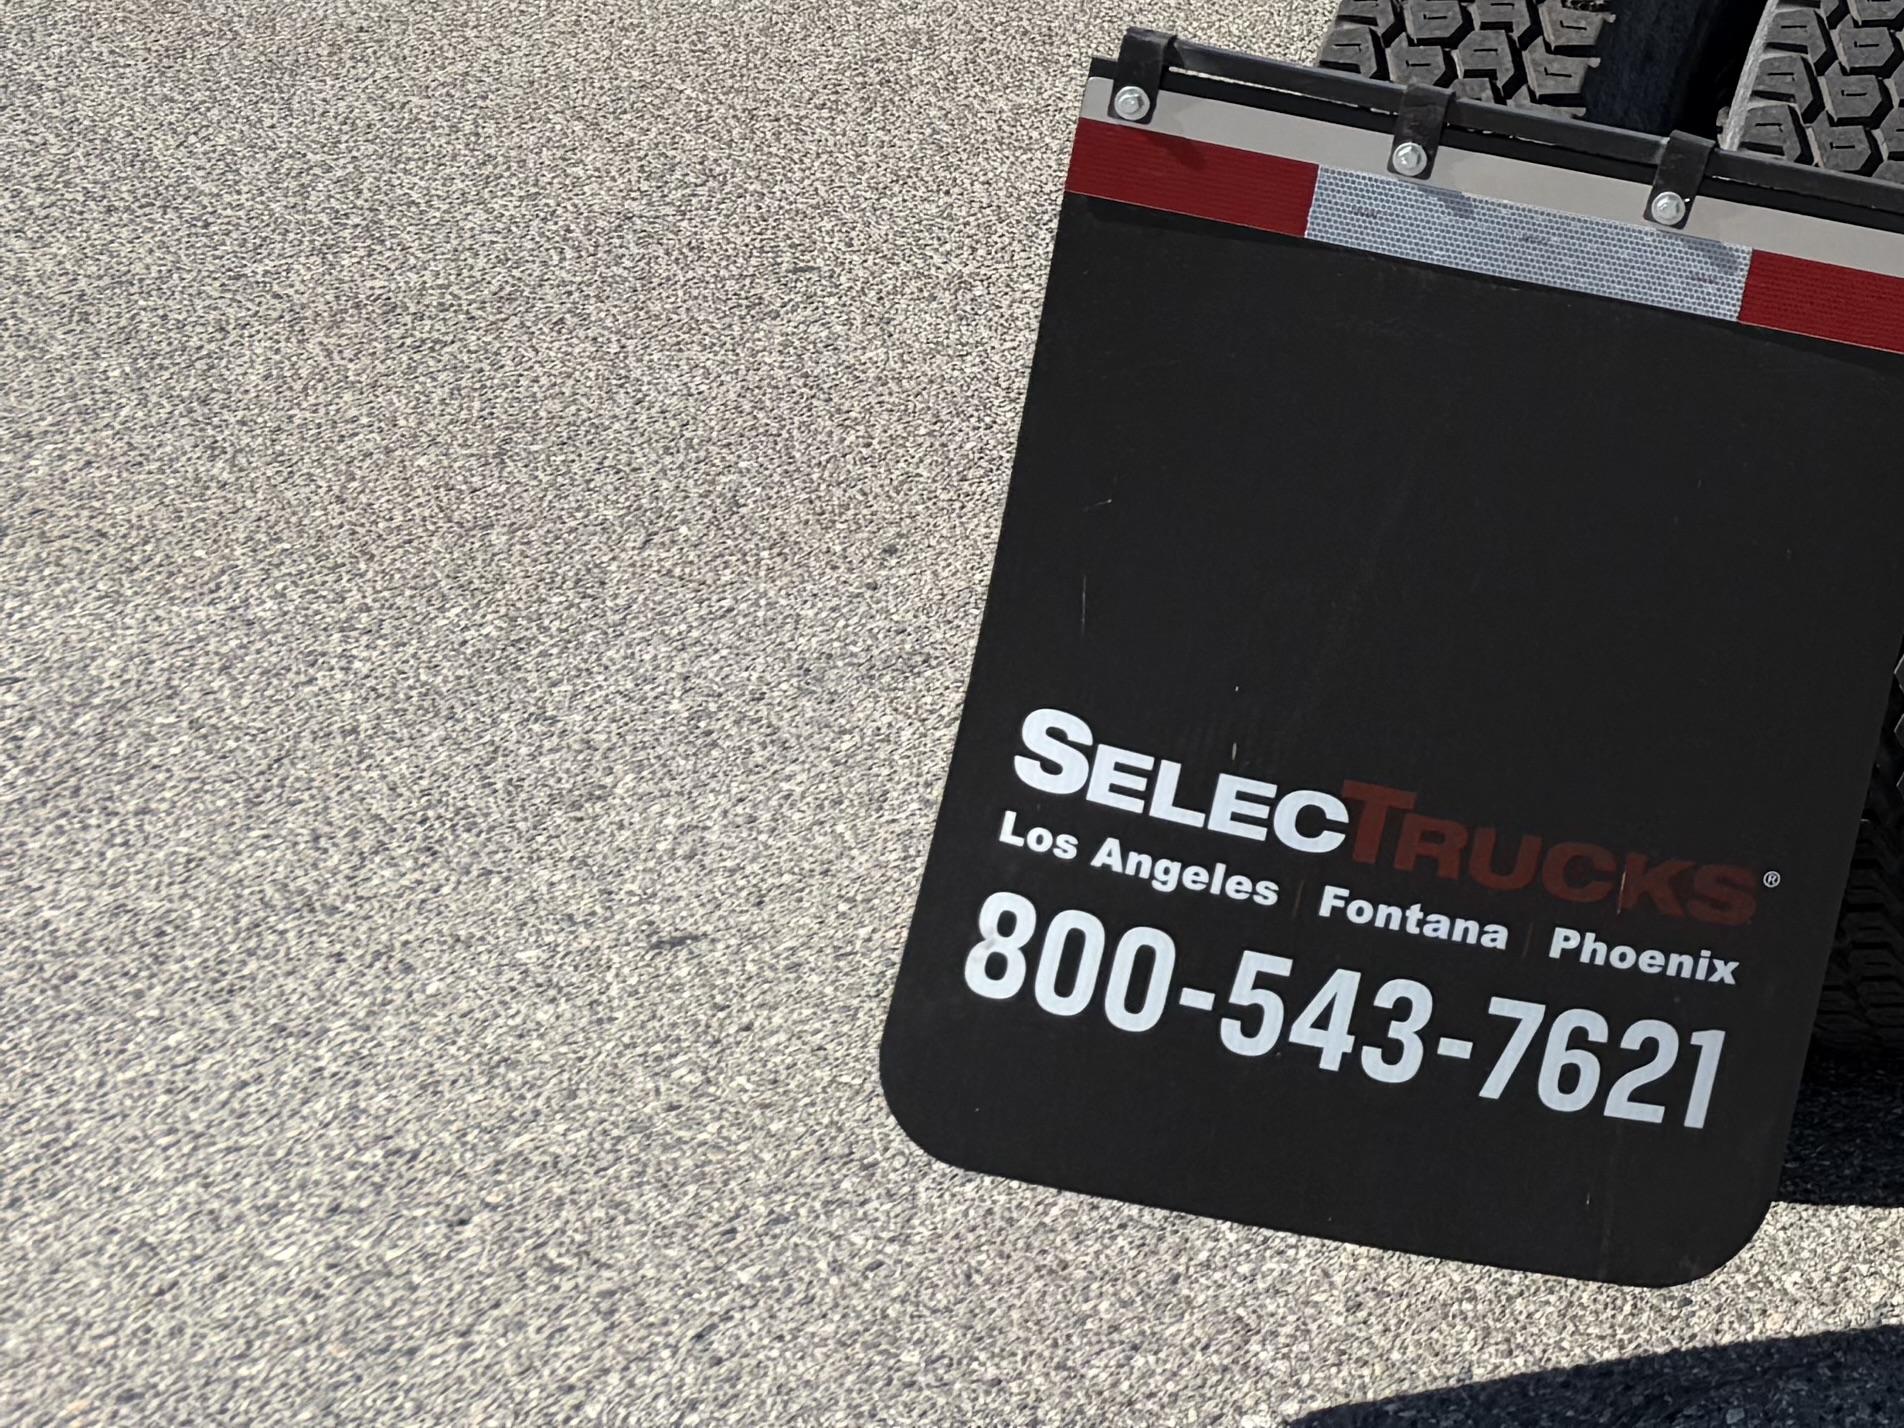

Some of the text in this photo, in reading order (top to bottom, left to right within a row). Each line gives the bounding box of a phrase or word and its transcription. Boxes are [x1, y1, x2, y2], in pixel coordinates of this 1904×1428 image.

[998, 809, 1740, 985] Los Angeles Fontana Phoenix
[963, 891, 1726, 1129] 800-543-7621
